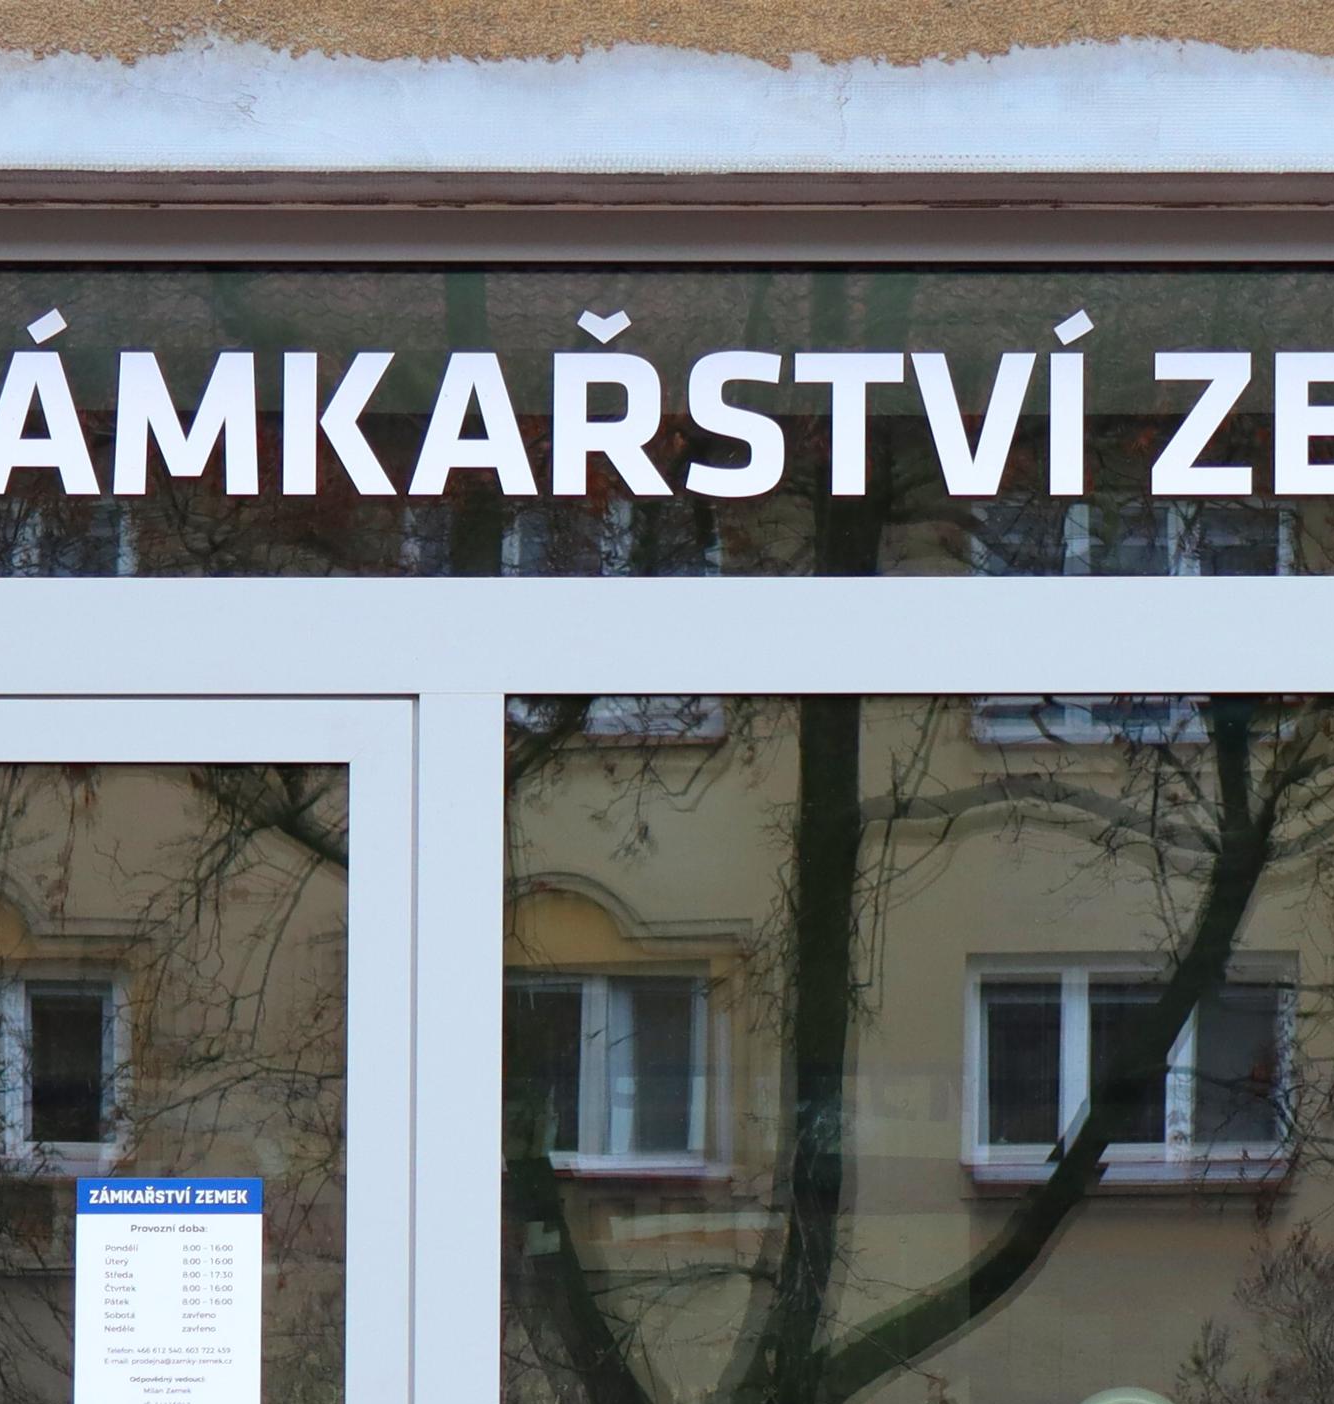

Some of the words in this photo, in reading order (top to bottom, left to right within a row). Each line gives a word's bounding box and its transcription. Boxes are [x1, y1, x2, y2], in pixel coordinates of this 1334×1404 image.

[89, 1186, 192, 1204] ZÁMKAŘSTVÍ
[195, 1189, 248, 1204] ZEMEK
[131, 1224, 176, 1233] Provozní
[179, 1224, 208, 1233] doba:
[105, 1244, 138, 1252] Pondělí
[105, 1257, 129, 1266] Úterý
[105, 1271, 133, 1279] Středa
[104, 1283, 136, 1292] Čtvrtek
